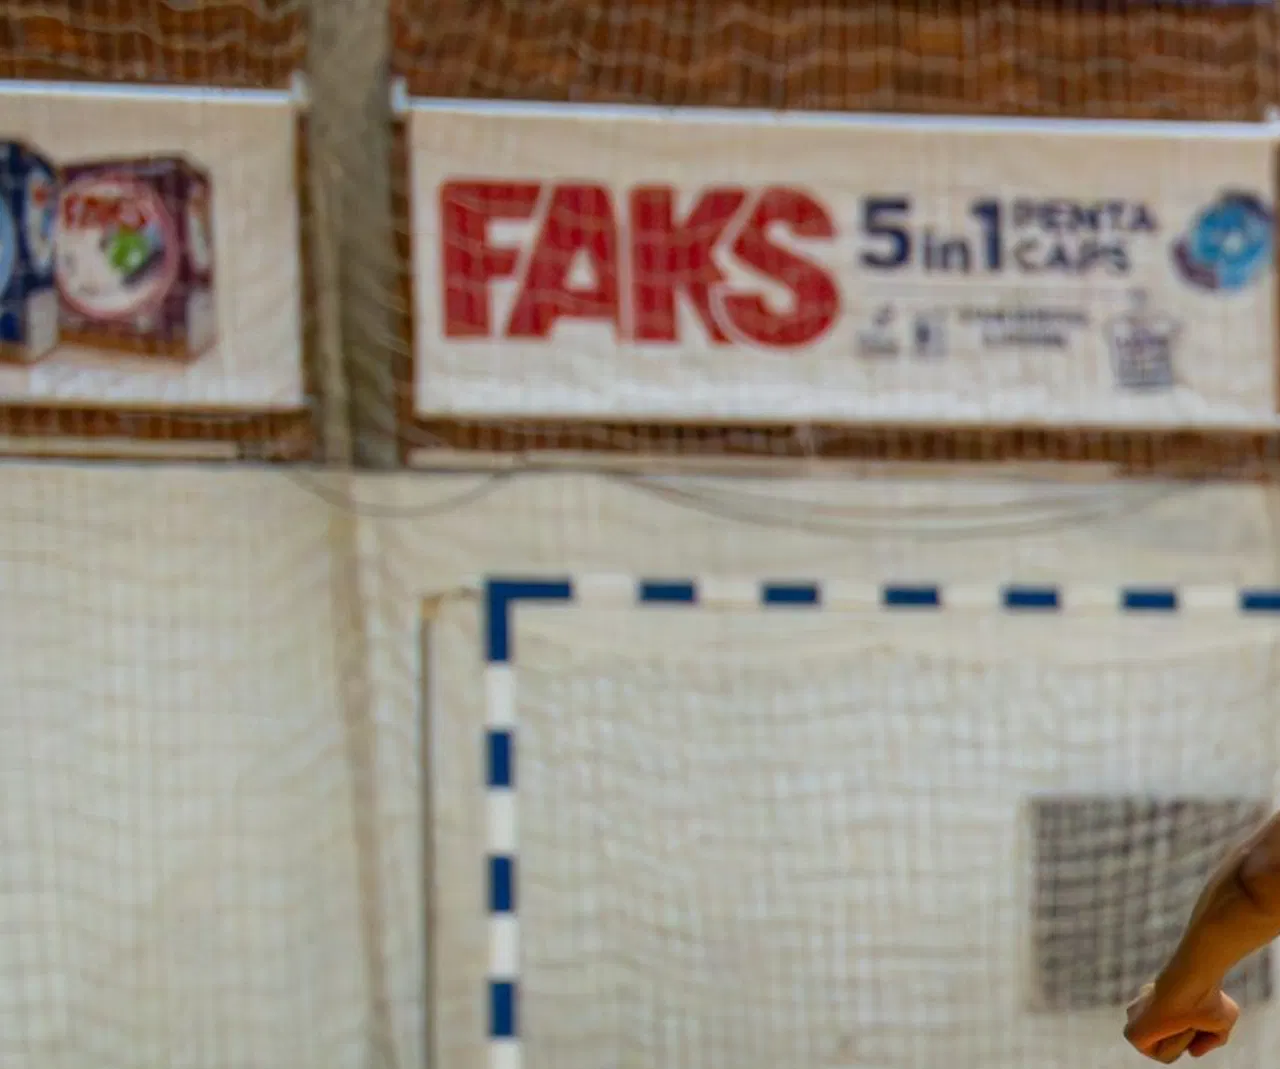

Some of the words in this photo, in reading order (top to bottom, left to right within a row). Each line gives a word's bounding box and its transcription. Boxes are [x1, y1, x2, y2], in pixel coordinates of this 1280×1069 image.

[1012, 199, 1158, 233] PENTA
[439, 174, 843, 350] FAKS
[1011, 238, 1132, 277] CAPS
